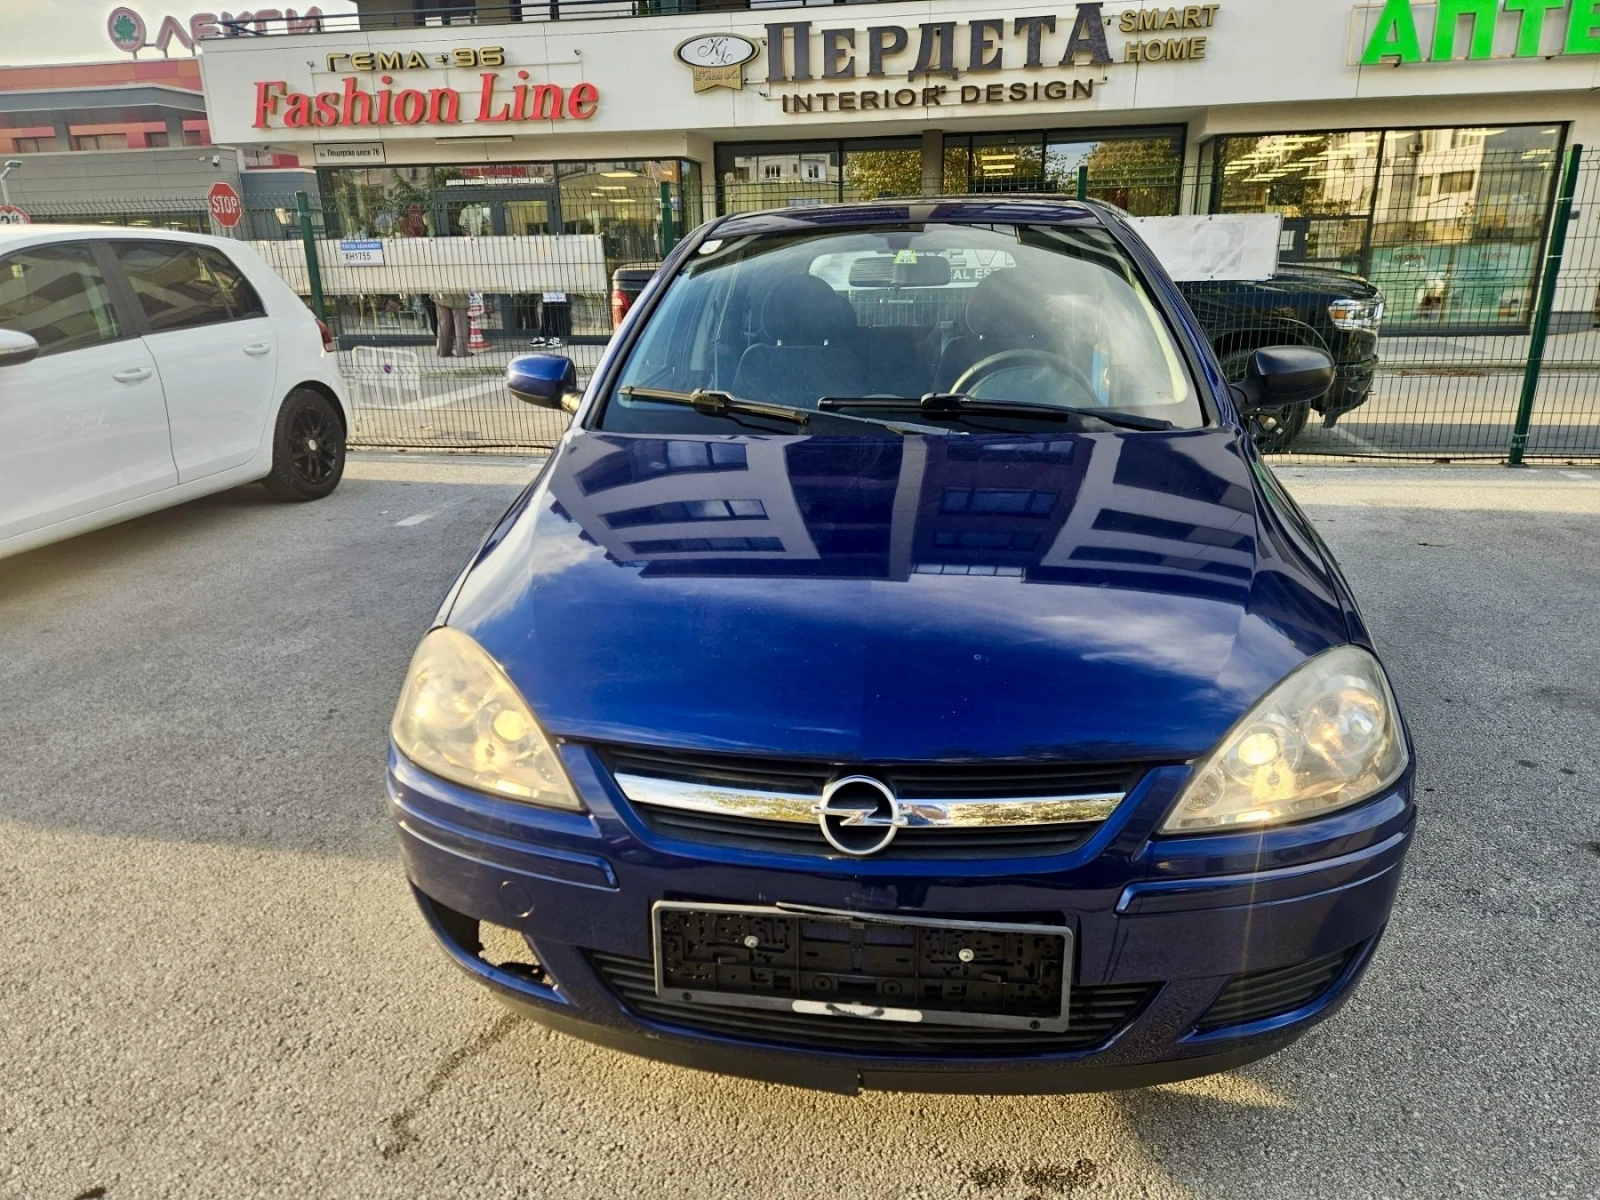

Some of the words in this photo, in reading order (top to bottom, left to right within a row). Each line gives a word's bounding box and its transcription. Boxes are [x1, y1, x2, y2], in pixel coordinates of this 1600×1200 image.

[1119, 4, 1220, 33] SMART
[764, 3, 1113, 82] ПЕРДЕТА
[1125, 36, 1206, 63] HOME
[252, 75, 461, 129] Fashion
[475, 70, 599, 122] Line
[781, 87, 941, 113] INTERIOR
[961, 78, 1095, 105] DESIGN
[212, 196, 238, 214] STOP
